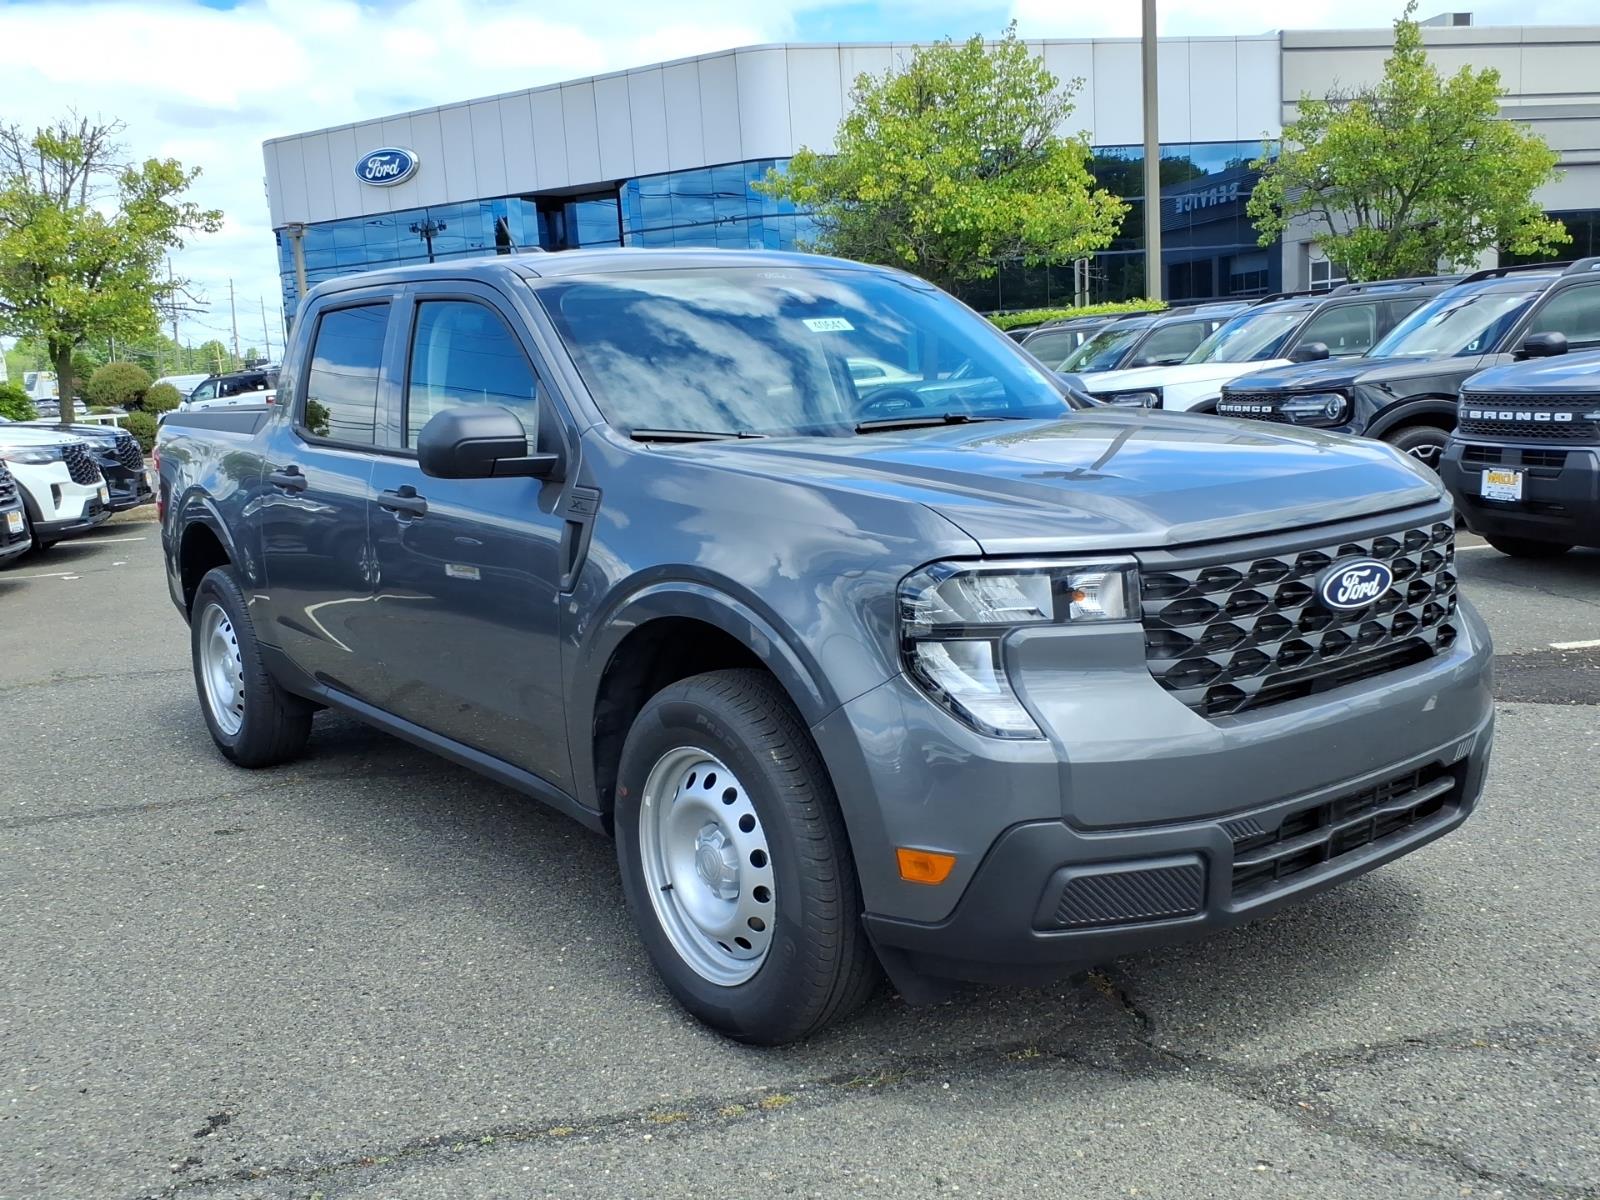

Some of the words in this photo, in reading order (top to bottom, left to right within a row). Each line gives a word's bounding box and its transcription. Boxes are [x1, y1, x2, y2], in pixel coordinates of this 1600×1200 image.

[365, 155, 401, 179] Ford
[1220, 404, 1272, 413] BRONCO
[1469, 410, 1573, 421] BRONCO
[1337, 568, 1381, 603] Ford
